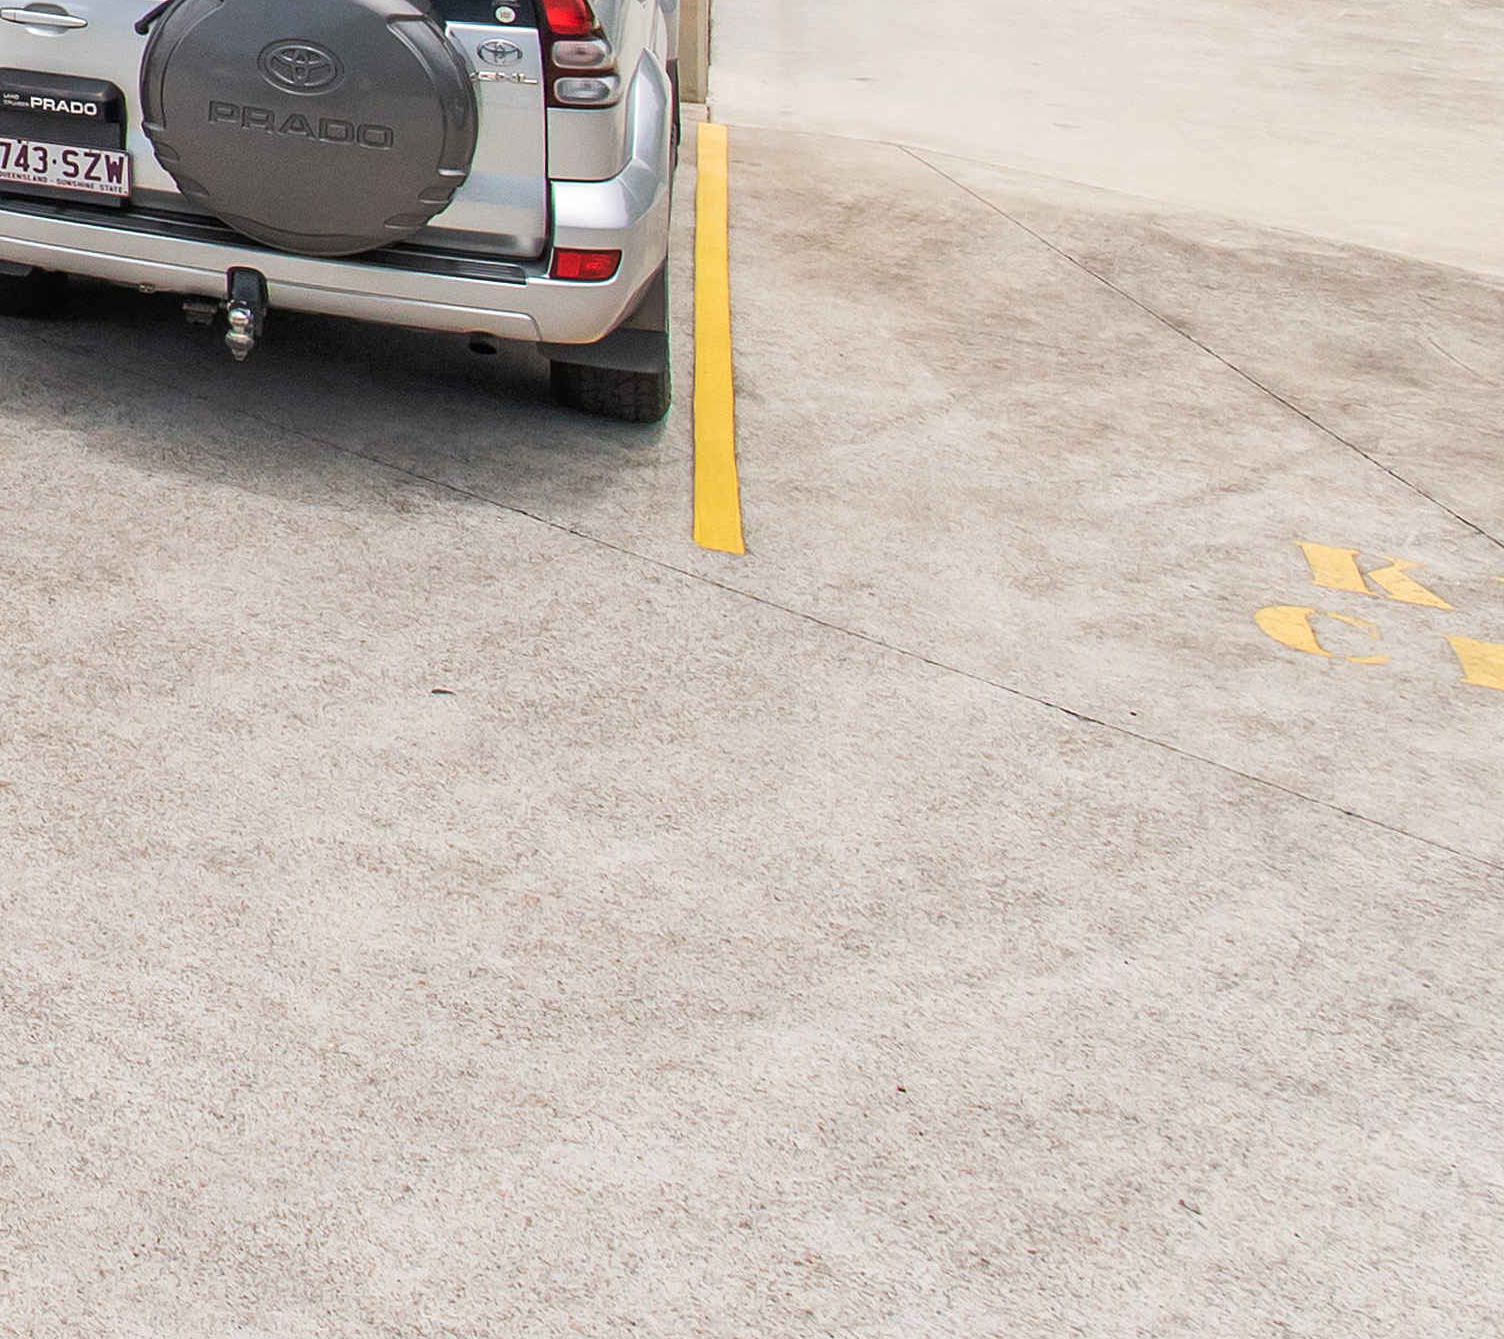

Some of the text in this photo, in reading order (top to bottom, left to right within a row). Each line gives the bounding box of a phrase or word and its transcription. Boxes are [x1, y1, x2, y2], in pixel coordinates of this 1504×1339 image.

[29, 96, 98, 116] PRADO
[208, 100, 394, 151] PRADO
[56, 178, 96, 190] SUNSHINE
[99, 184, 124, 195] STATE
